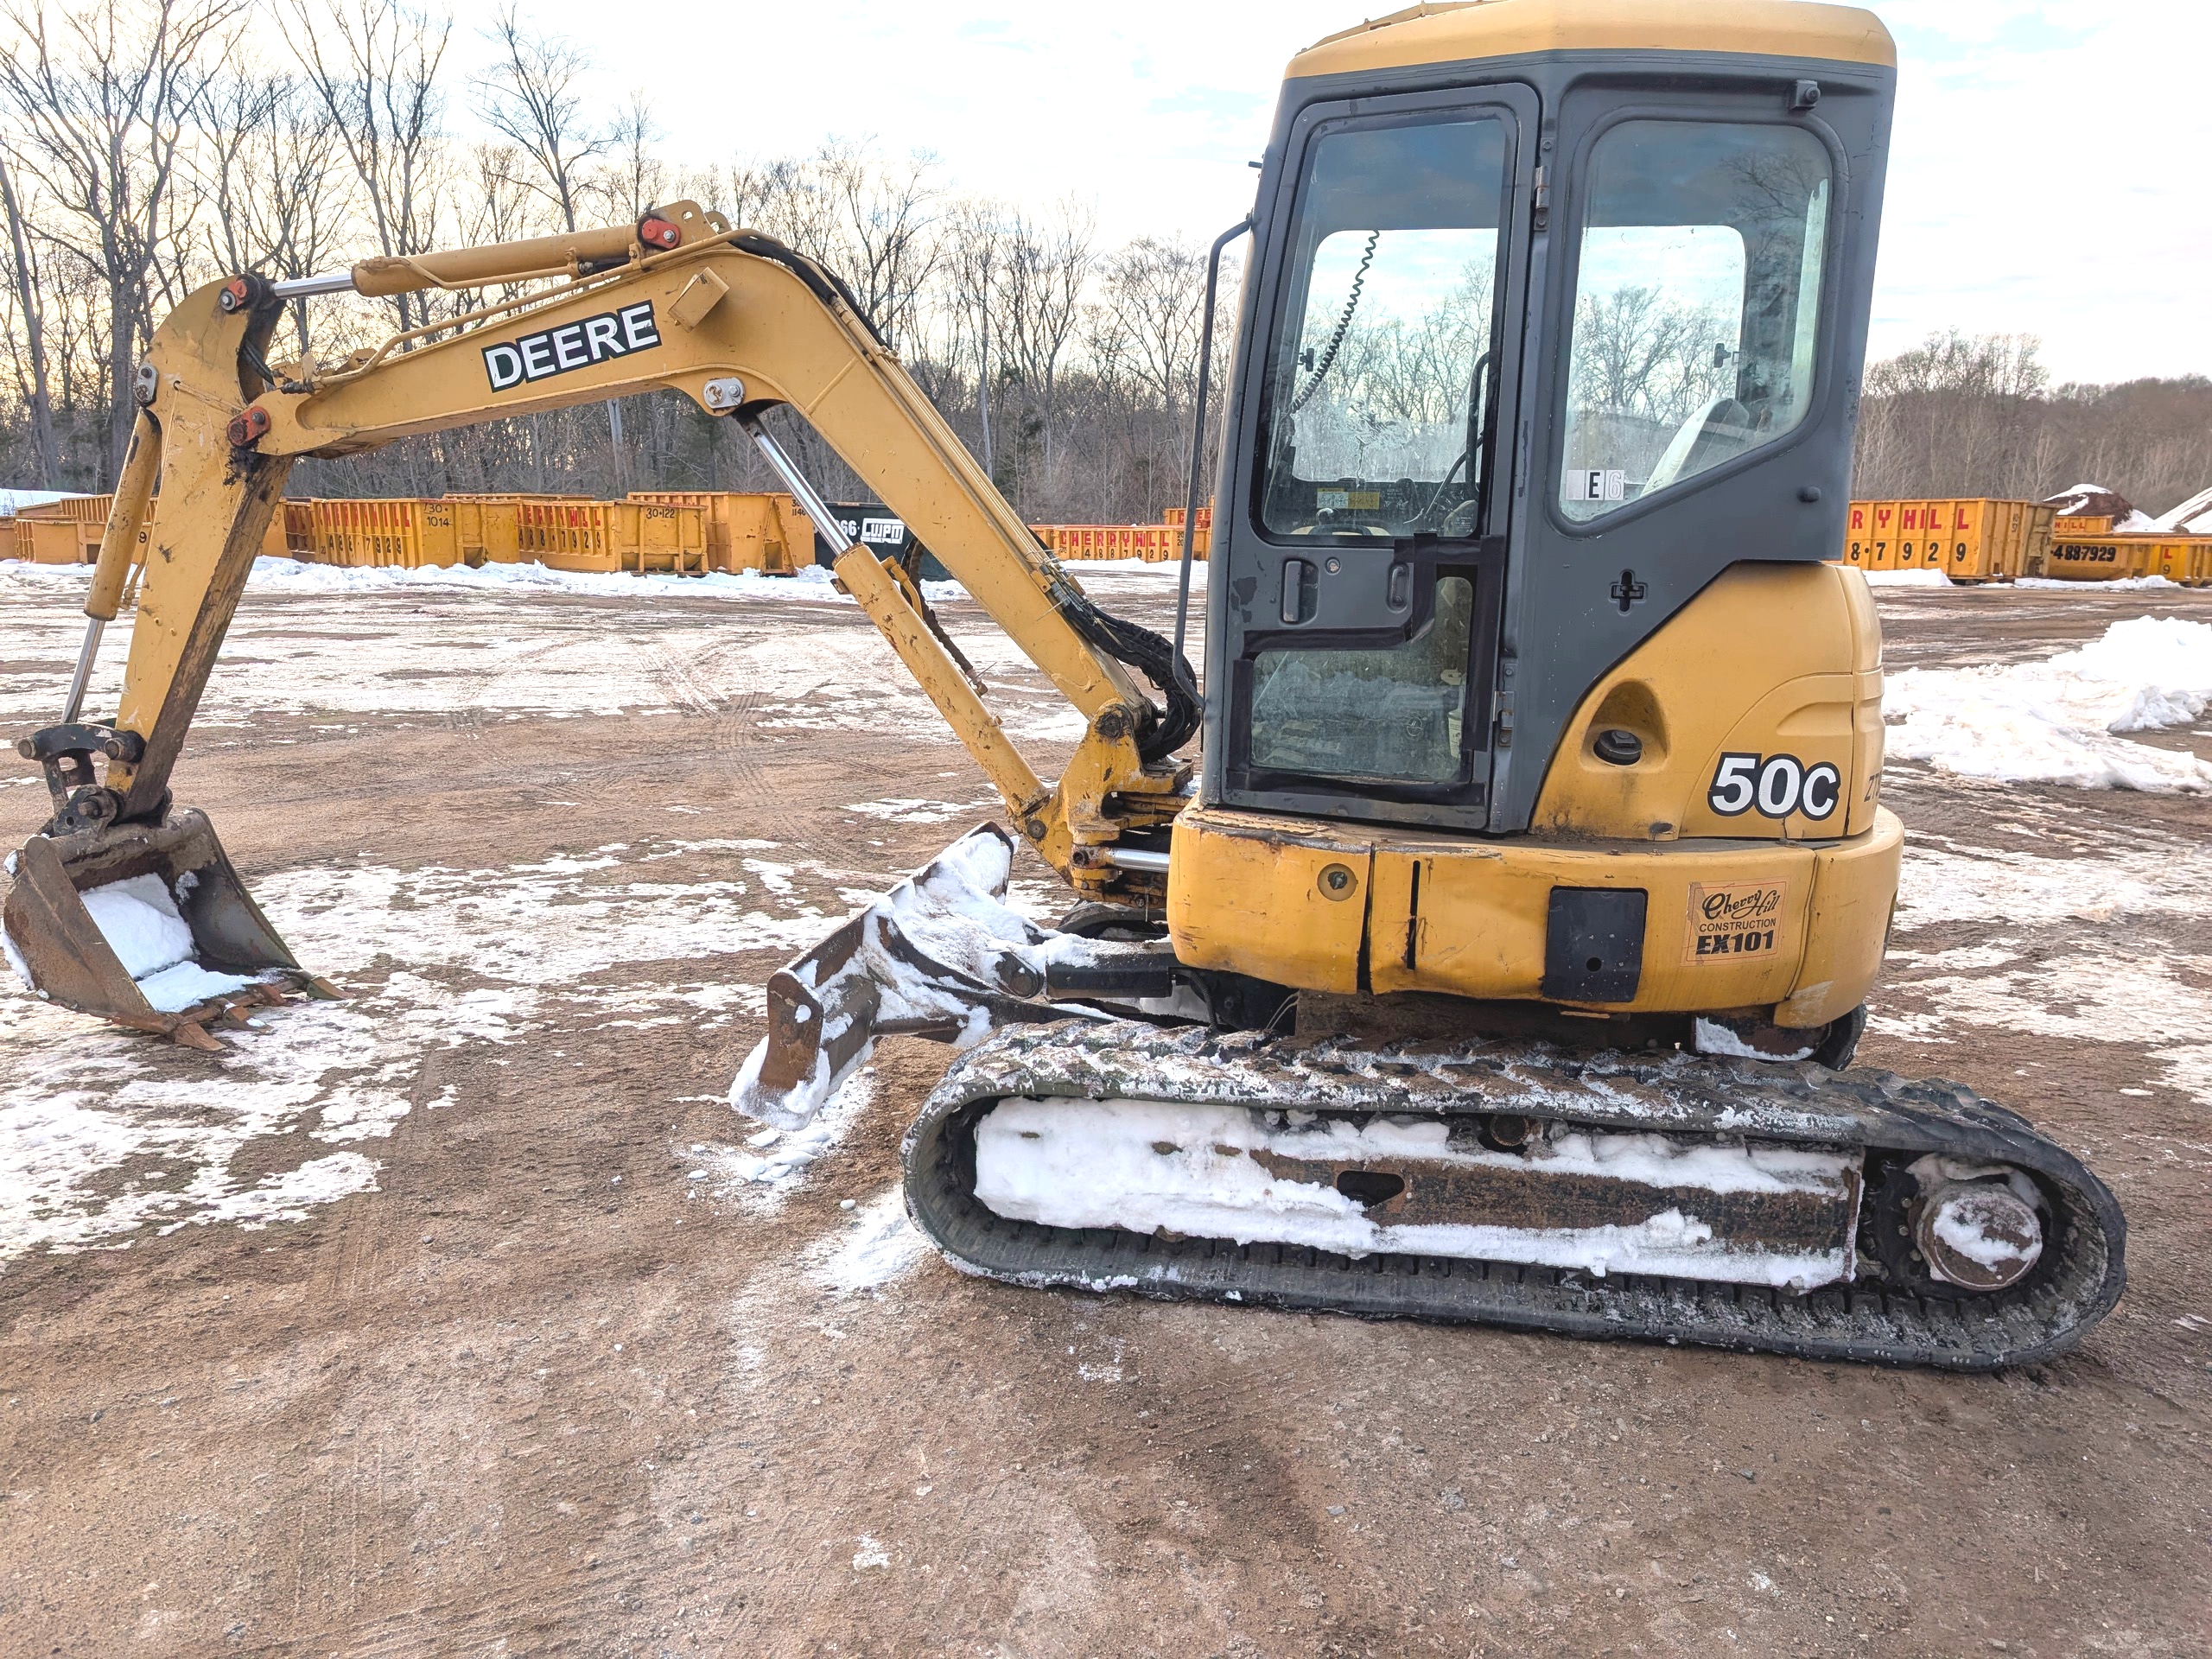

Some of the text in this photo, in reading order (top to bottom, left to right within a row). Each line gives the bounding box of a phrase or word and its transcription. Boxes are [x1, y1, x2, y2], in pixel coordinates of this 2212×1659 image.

[485, 304, 658, 389] DEERE
[426, 516, 449, 527] 1014
[1710, 755, 1839, 817] 50C
[1701, 889, 1763, 920] Cherry
[1699, 917, 1777, 932] CONSTRUCTION
[1695, 929, 1775, 956] EX101
